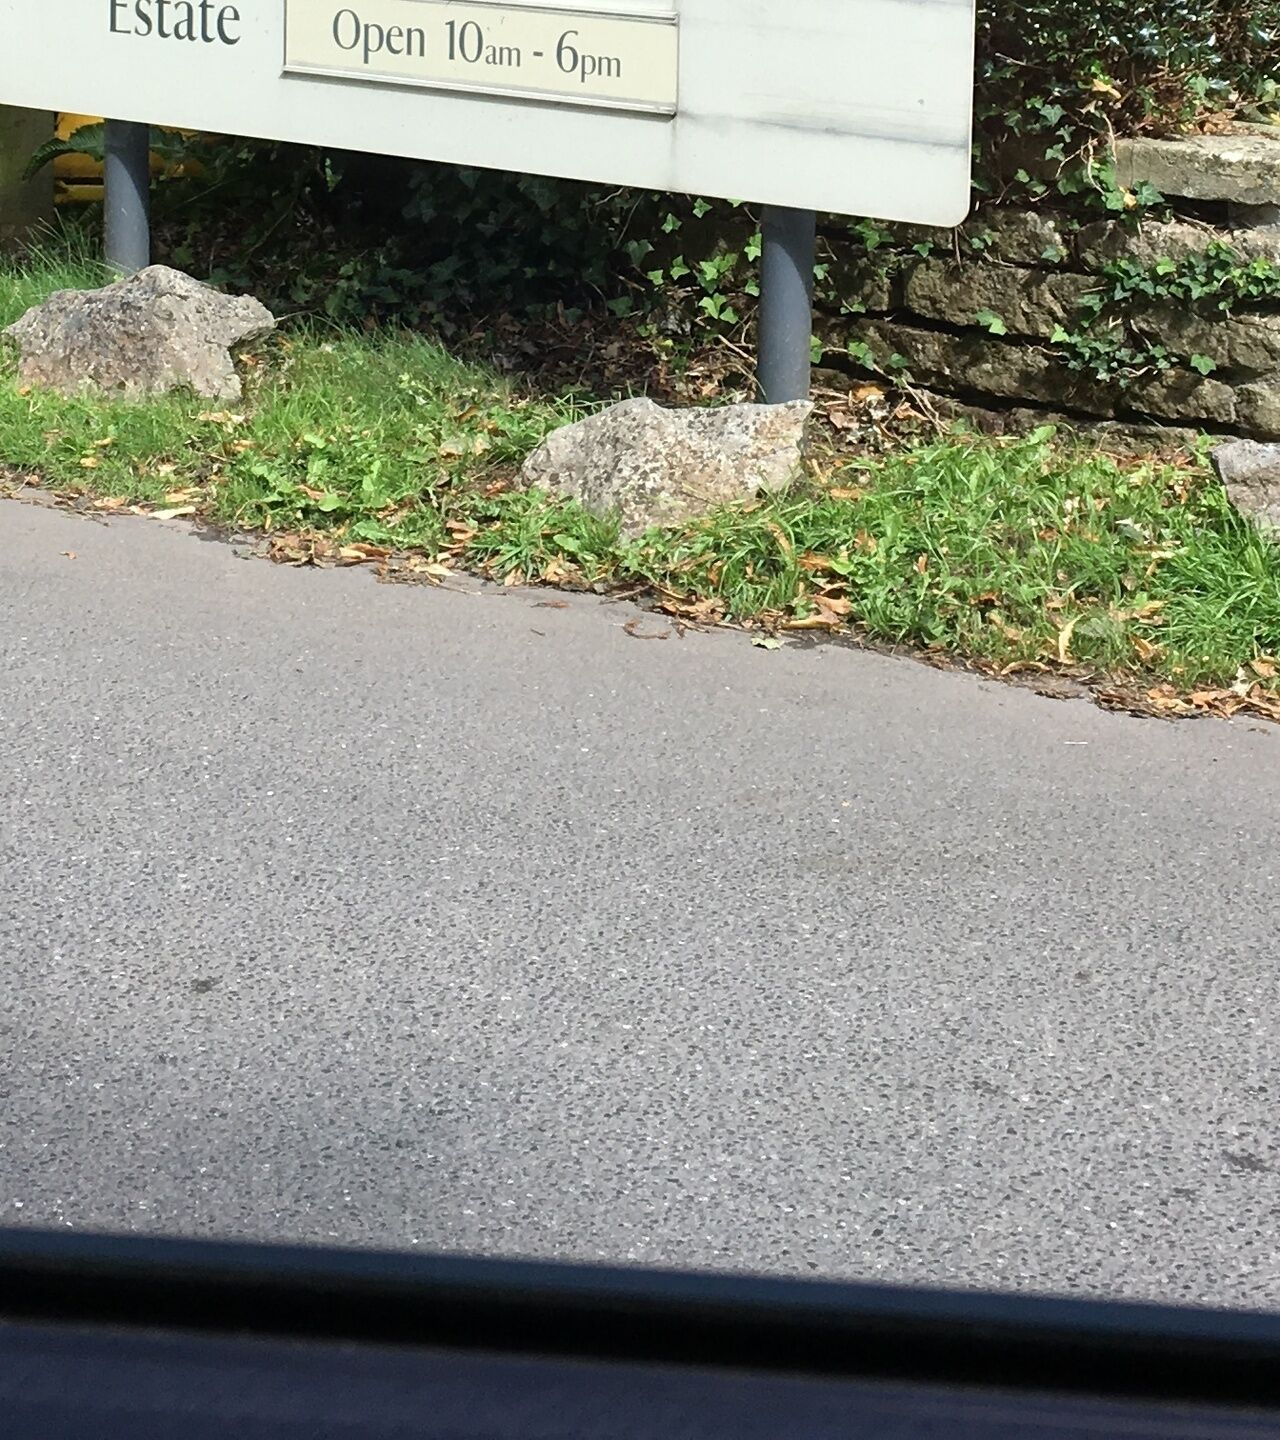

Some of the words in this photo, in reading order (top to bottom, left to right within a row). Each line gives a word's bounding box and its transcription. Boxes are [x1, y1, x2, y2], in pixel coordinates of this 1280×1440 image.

[332, 8, 426, 64] Open
[444, 19, 521, 68] 10am
[555, 29, 622, 83] 6pm
